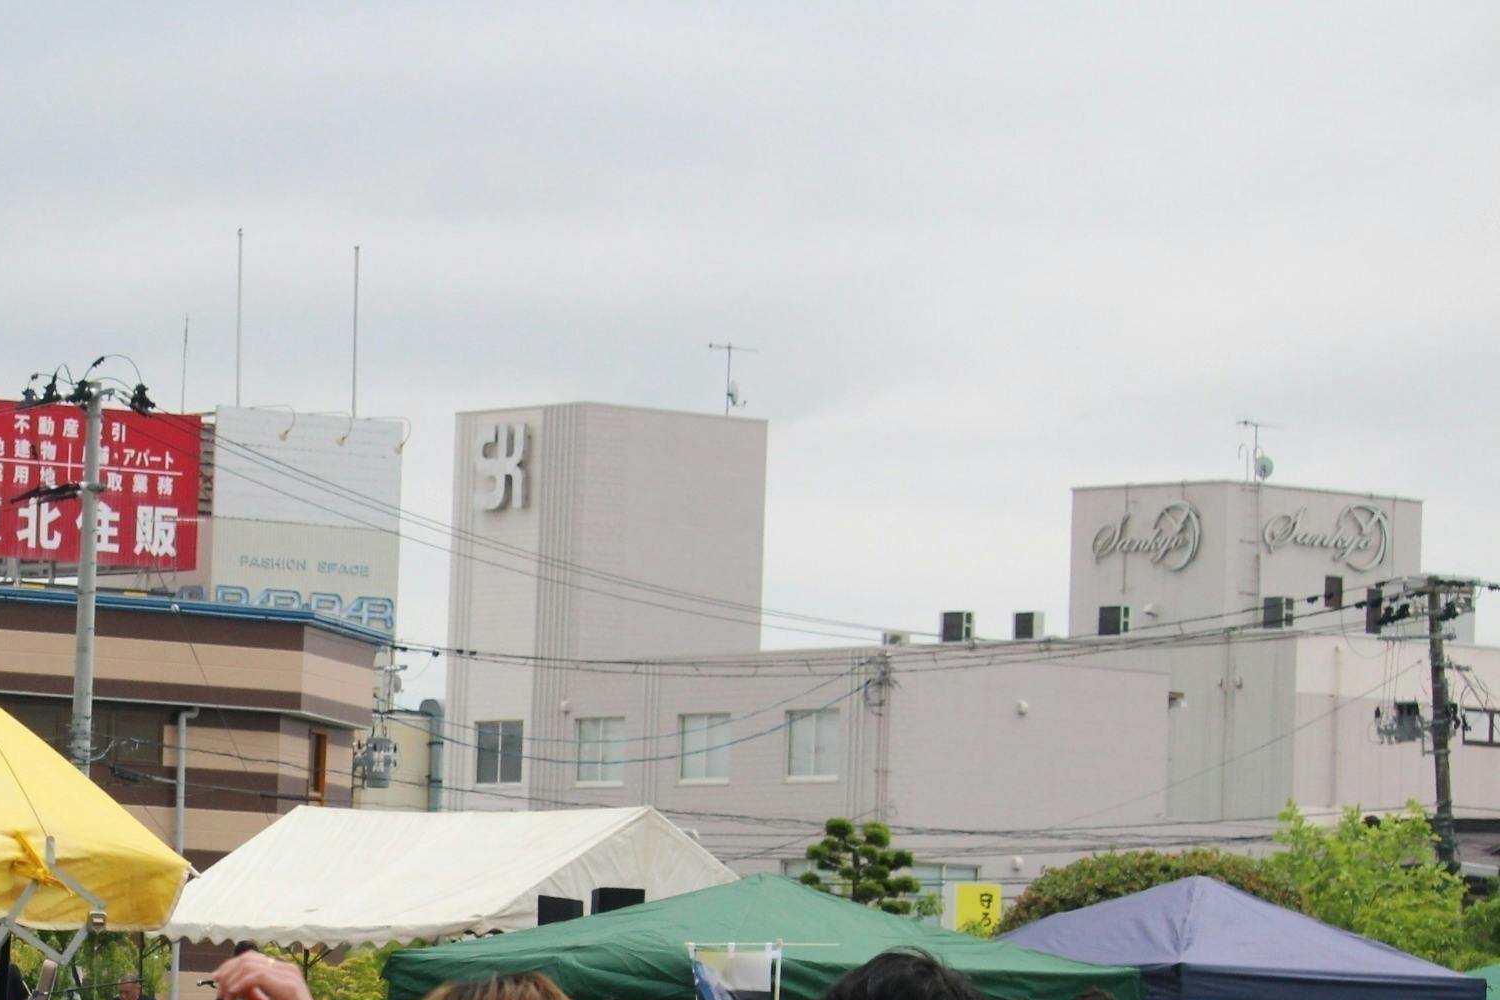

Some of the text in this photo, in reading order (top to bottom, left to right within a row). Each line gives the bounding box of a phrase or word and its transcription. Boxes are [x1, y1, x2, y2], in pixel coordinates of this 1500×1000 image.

[82, 468, 174, 497] 取業務
[239, 554, 370, 577] FASHION SPACE
